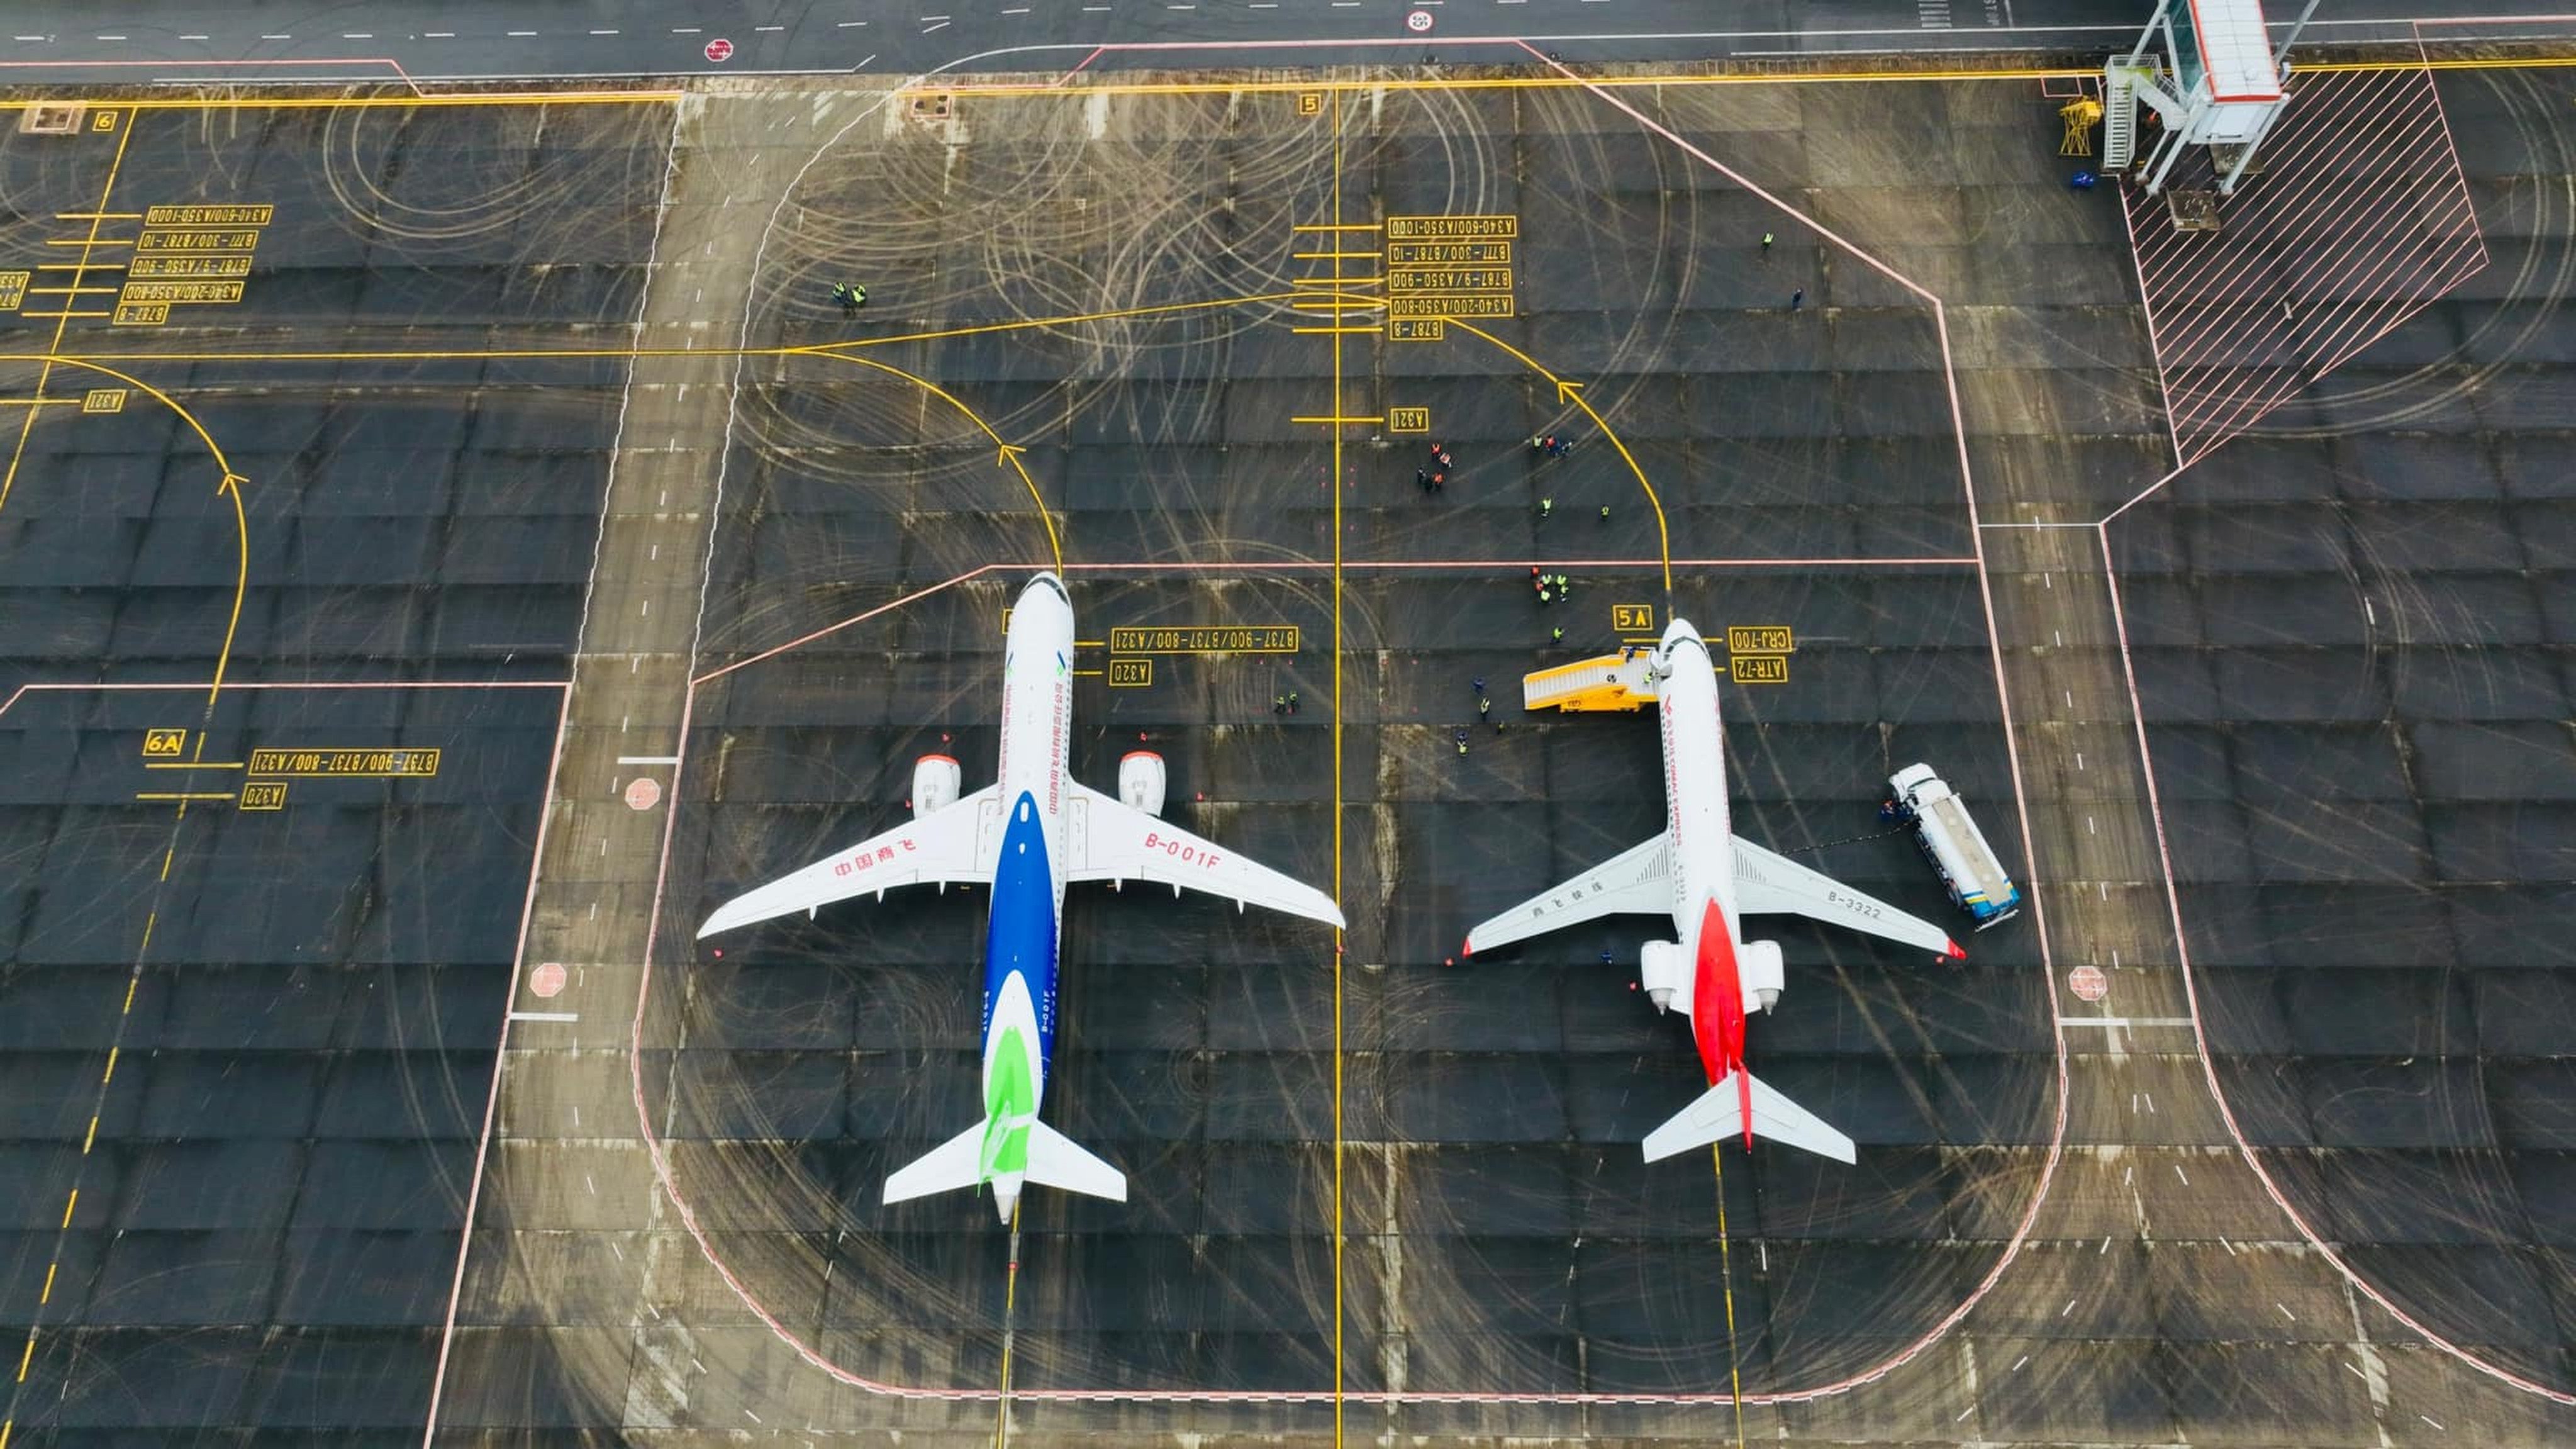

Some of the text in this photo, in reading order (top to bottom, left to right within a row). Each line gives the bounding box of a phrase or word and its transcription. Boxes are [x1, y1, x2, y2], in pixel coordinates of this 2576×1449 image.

[1305, 98, 1315, 111] 5
[98, 116, 110, 127] 6
[1393, 245, 1505, 260] B777-300/B787-10
[1393, 272, 1509, 288] B787-9/A350-900
[1393, 322, 1439, 336] B787-8
[89, 393, 119, 409] A321
[1394, 412, 1422, 427] A321
[1114, 629, 1294, 649] B737-900/B737-800/A321
[1735, 632, 1786, 647] CRJ-700
[1114, 664, 1147, 681] A320
[1737, 661, 1781, 677] ATR-72
[150, 734, 178, 751] 6A
[254, 753, 434, 770] B737-900/B737-800/A321
[247, 787, 281, 805] A320
[835, 839, 917, 876] 中国商飞
[1145, 832, 1220, 869] B-001F
[1828, 891, 1882, 919] B-3322
